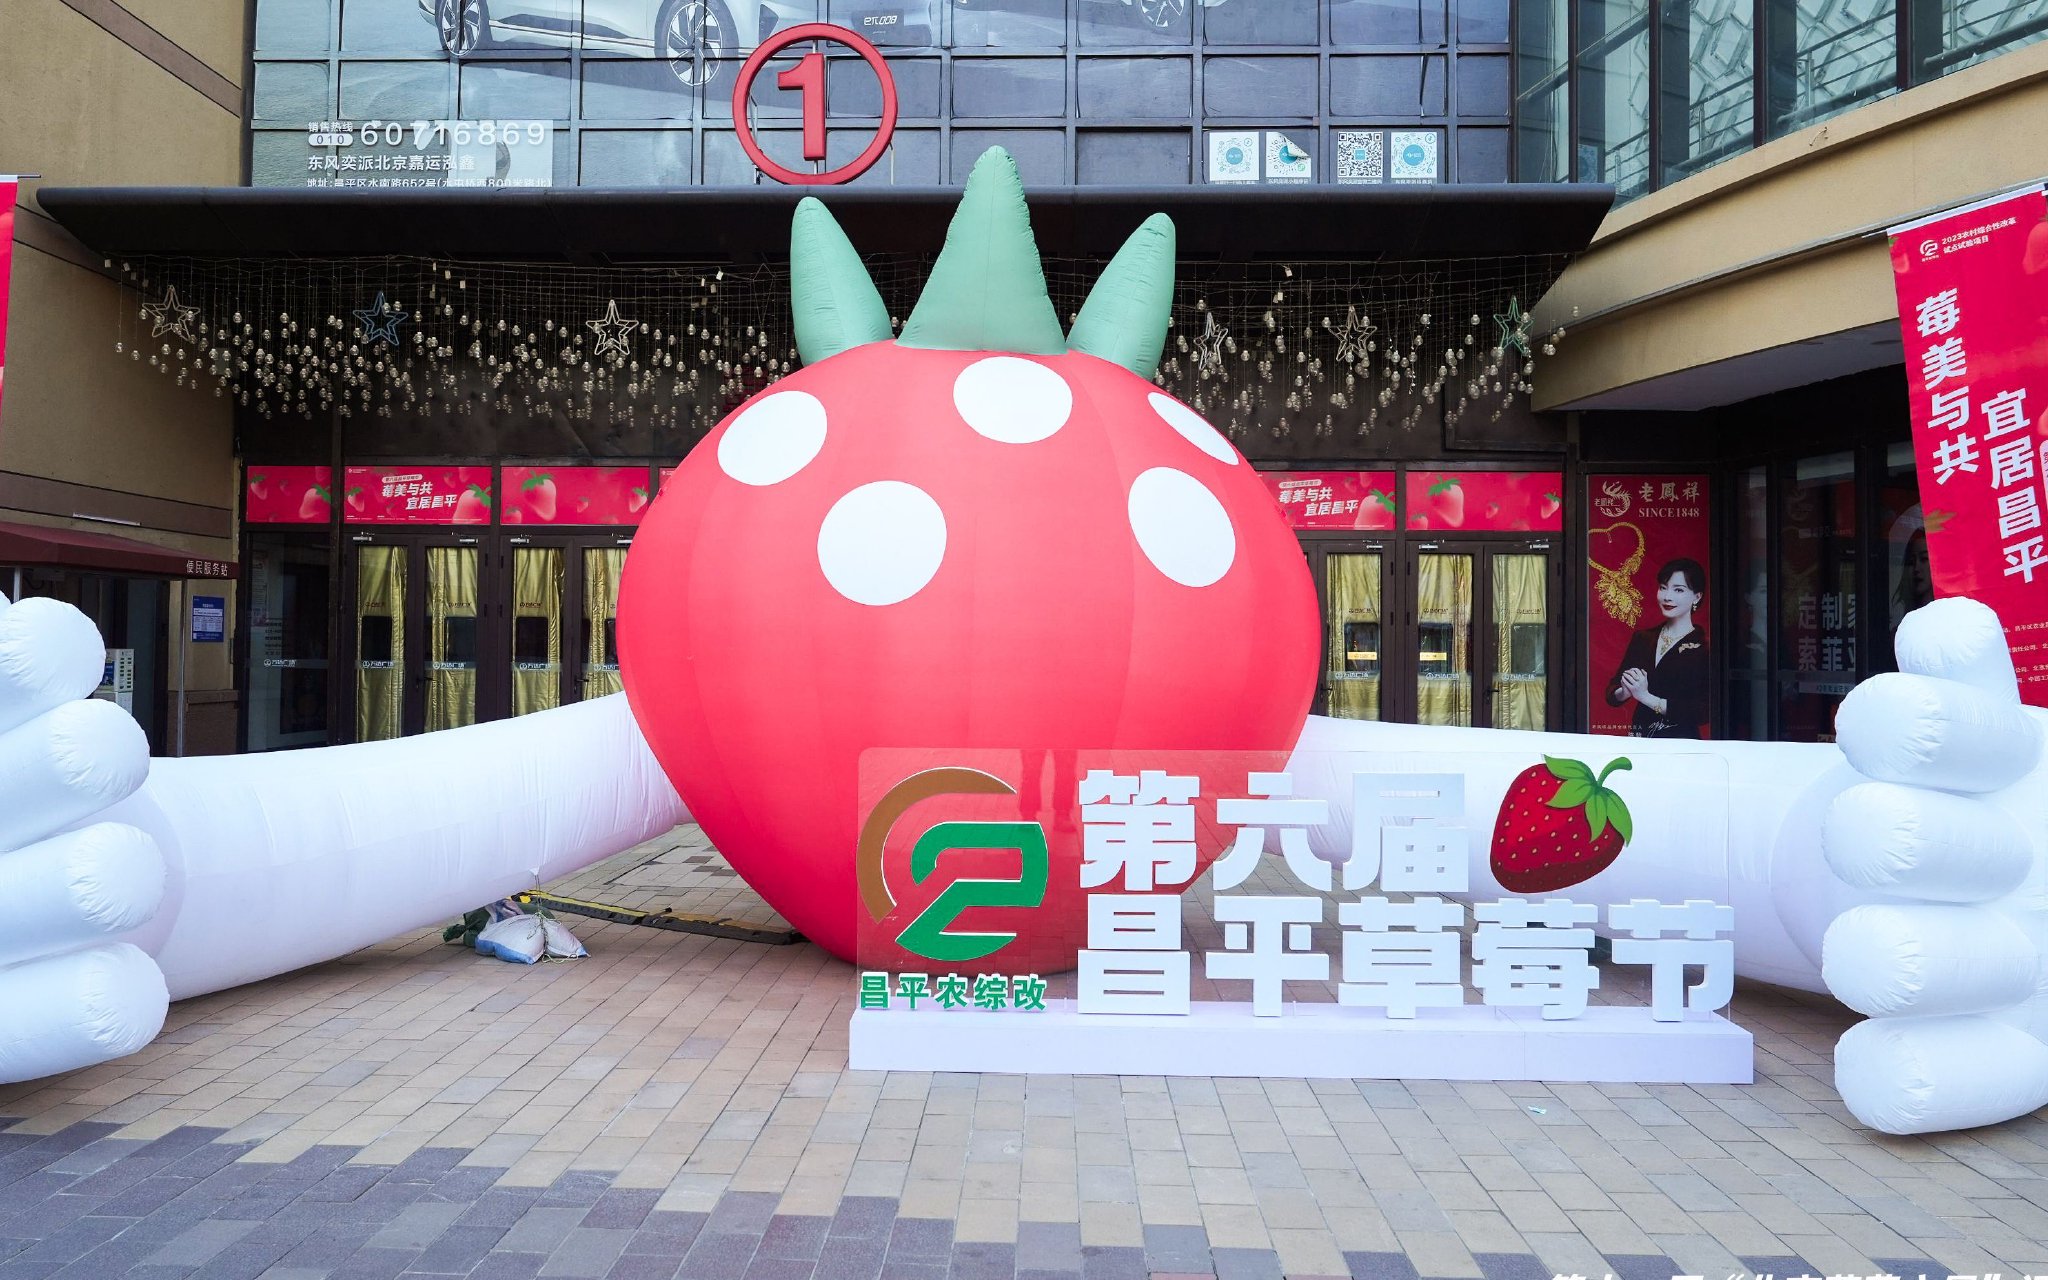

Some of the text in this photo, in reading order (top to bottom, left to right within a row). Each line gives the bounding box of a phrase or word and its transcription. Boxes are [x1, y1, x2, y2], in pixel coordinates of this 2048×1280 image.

[777, 52, 828, 161] 1
[308, 121, 353, 133] 销售热线
[360, 122, 546, 146] 60716869
[316, 134, 346, 145] 010
[307, 155, 476, 171] 东风奕派北京嘉运泓鑫
[1915, 287, 1980, 486] 莓美与共
[382, 482, 433, 498] 莓美与共
[1981, 387, 2048, 584] 宜居昌平
[405, 494, 457, 510] 宜居昌平
[1278, 487, 1332, 503] 莓美与共
[1304, 499, 1359, 516] 宜居昌平
[186, 560, 228, 577] 便民服务站
[1079, 770, 1469, 892] 第六届
[1077, 893, 1736, 1023] 昌平草莓节
[858, 971, 1049, 1012] 昌平农综改
